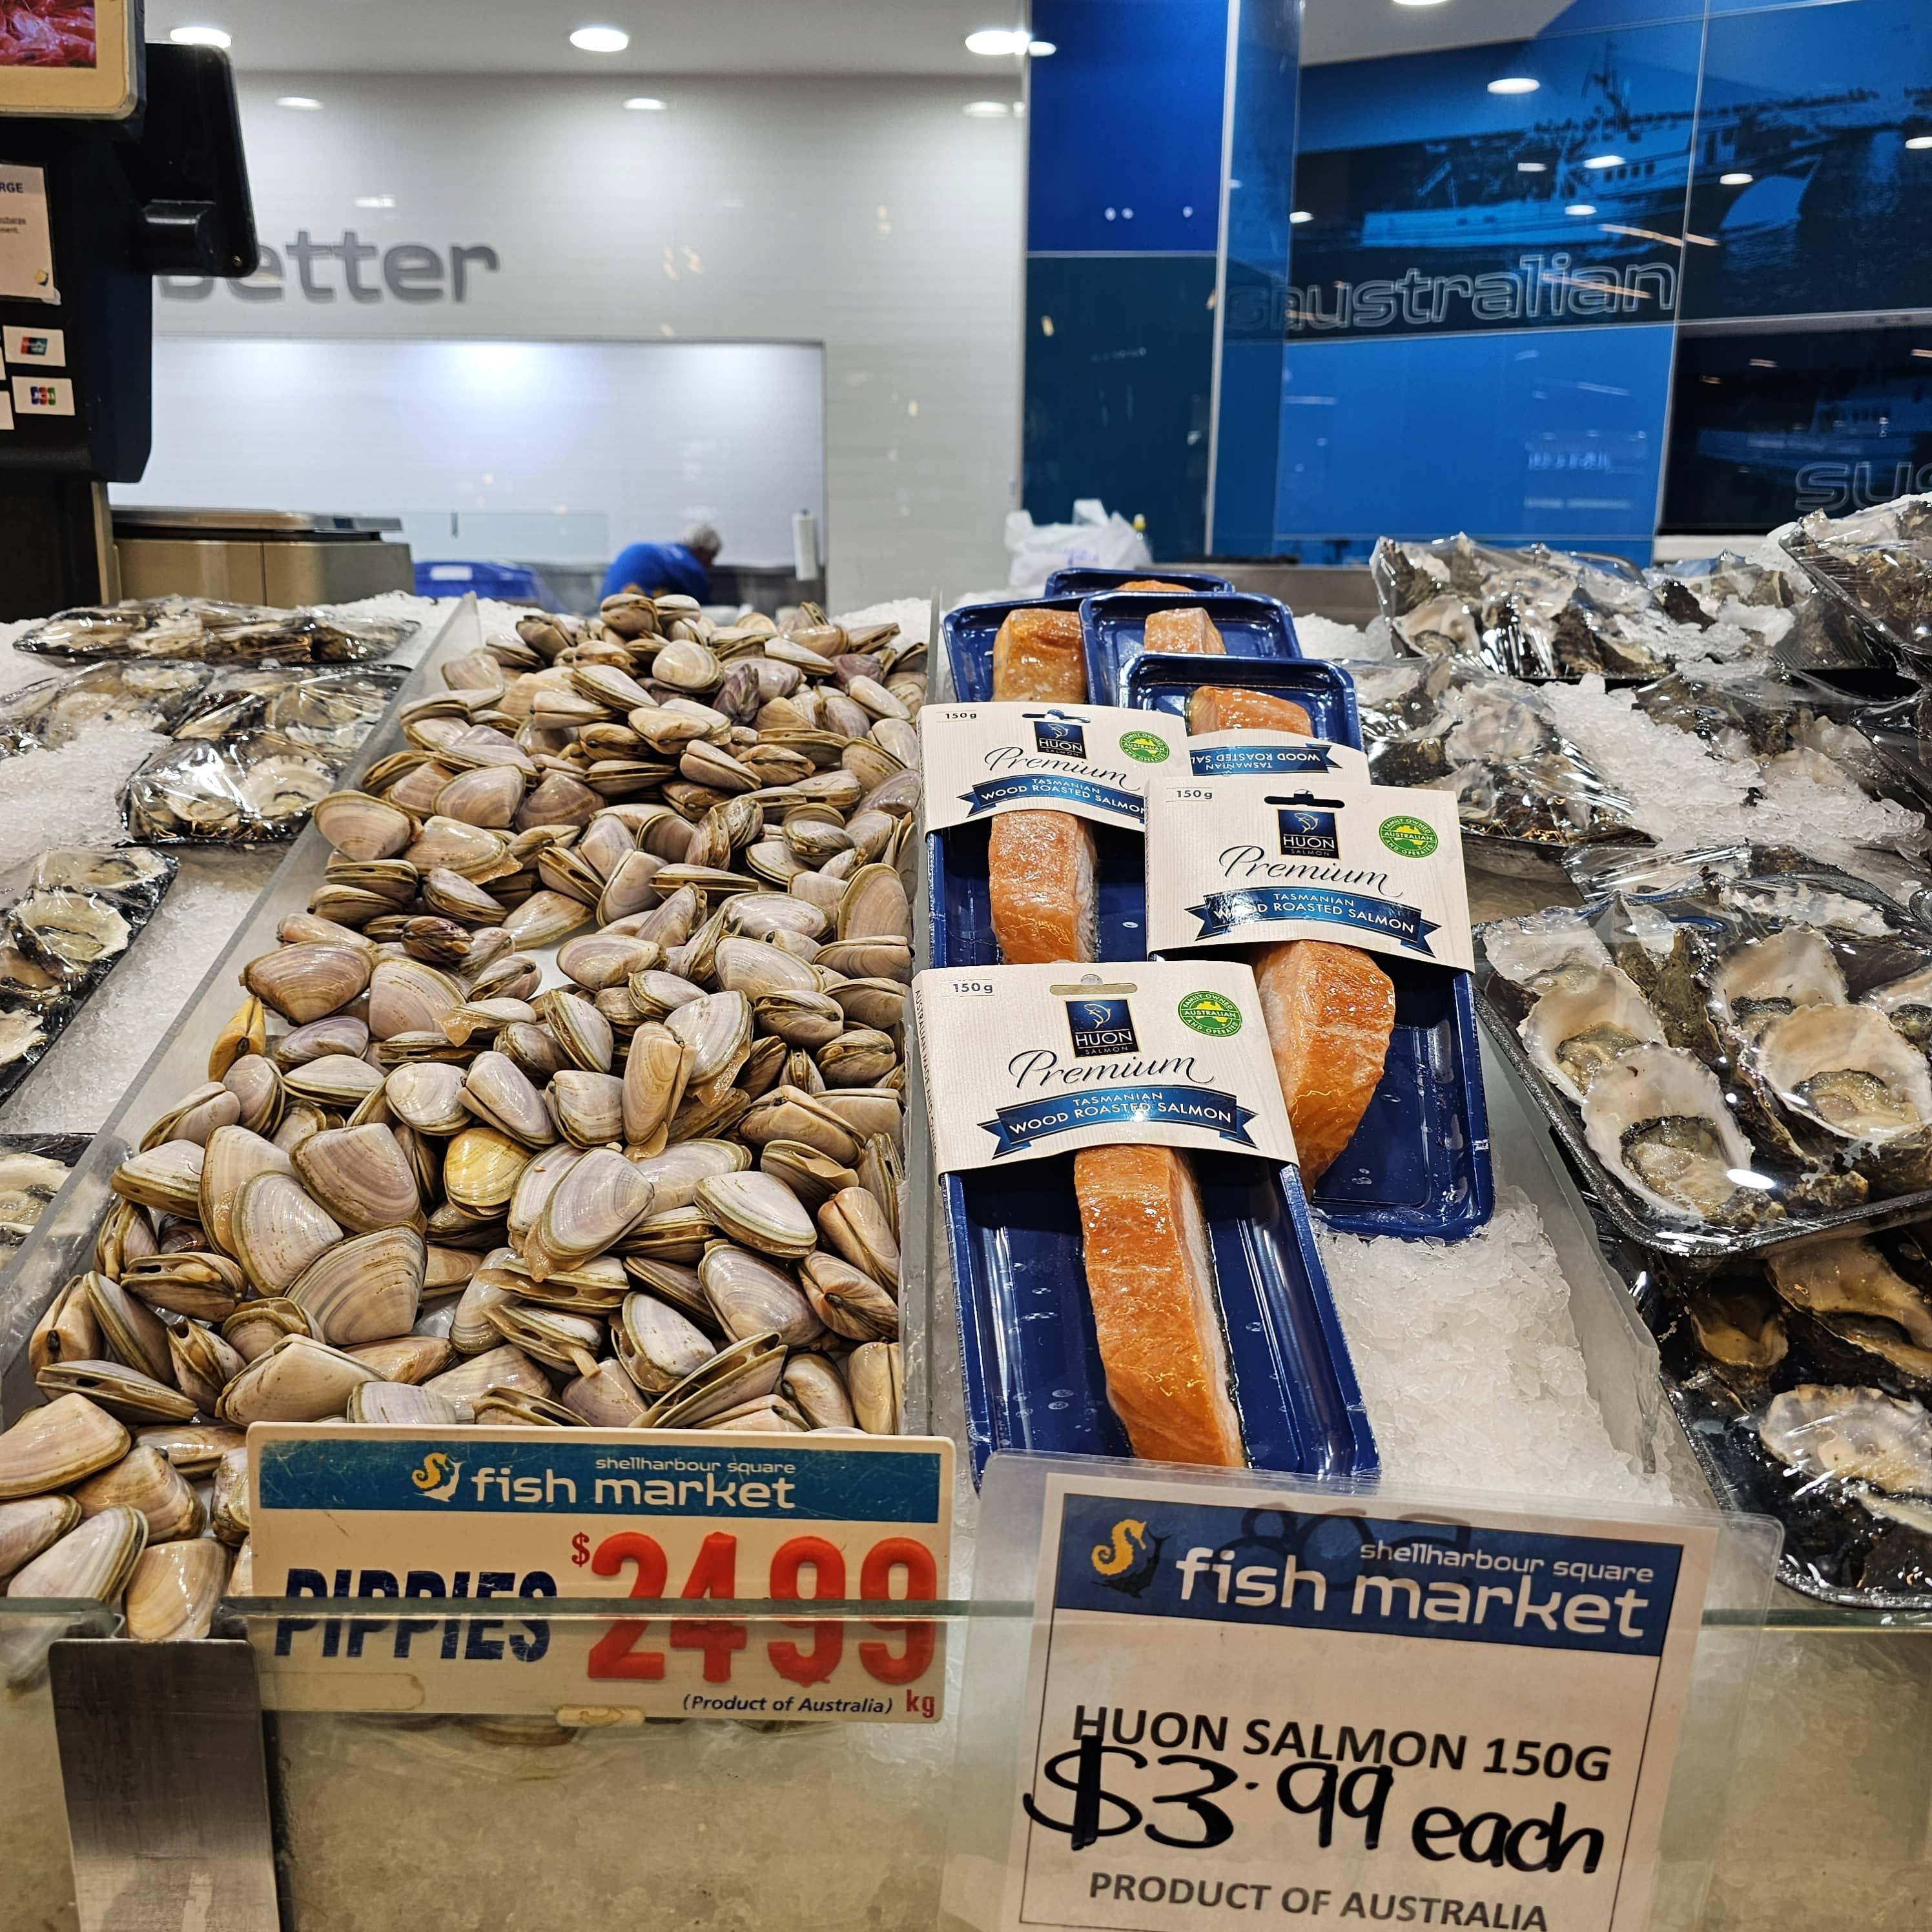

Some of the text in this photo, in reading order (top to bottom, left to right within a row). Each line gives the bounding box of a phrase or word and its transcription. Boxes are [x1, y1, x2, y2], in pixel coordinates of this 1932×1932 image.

[1039, 739, 1084, 752] HUON
[1124, 743, 1165, 751] AUSTRALIAN
[1277, 753, 1321, 761] WOOD
[984, 746, 1141, 792] Premium
[1206, 762, 1273, 770] TASMANIAN
[981, 785, 1027, 801] WOOD
[1032, 785, 1091, 799] ROASTED
[1032, 778, 1100, 794] TASMANIAN
[1283, 836, 1335, 849] HUON
[1384, 832, 1433, 841] AUSTRALIAN
[1219, 845, 1403, 898] Premium
[1273, 893, 1354, 907] TASMANIAN
[1273, 903, 1342, 915] ROASTED
[1348, 909, 1414, 934] SALMON
[1183, 994, 1233, 1010] FAMILY OWNED
[1186, 1019, 1202, 1030] AND
[1075, 1031, 1133, 1046] HUON
[1085, 1046, 1128, 1055] SALMON
[1008, 1050, 1215, 1089] Premium
[1073, 1092, 1163, 1106] TASMANIAN
[1009, 1102, 1231, 1135] WOOD ROASTED SALMON
[595, 1457, 796, 1474] shellharbour square
[471, 1467, 796, 1509] fish market
[1360, 1541, 1654, 1583] shellharbour square
[1175, 1547, 1650, 1638] fish market
[274, 1568, 558, 1663] PIPPIES
[683, 1694, 893, 1714] (Product of Australia)
[905, 1689, 935, 1718] kg
[1073, 1705, 1612, 1782] HUON SALMON 150G
[1412, 1802, 1605, 1875] each
[1089, 1871, 1548, 1932] PRODUCT OF AUSTRALIA
